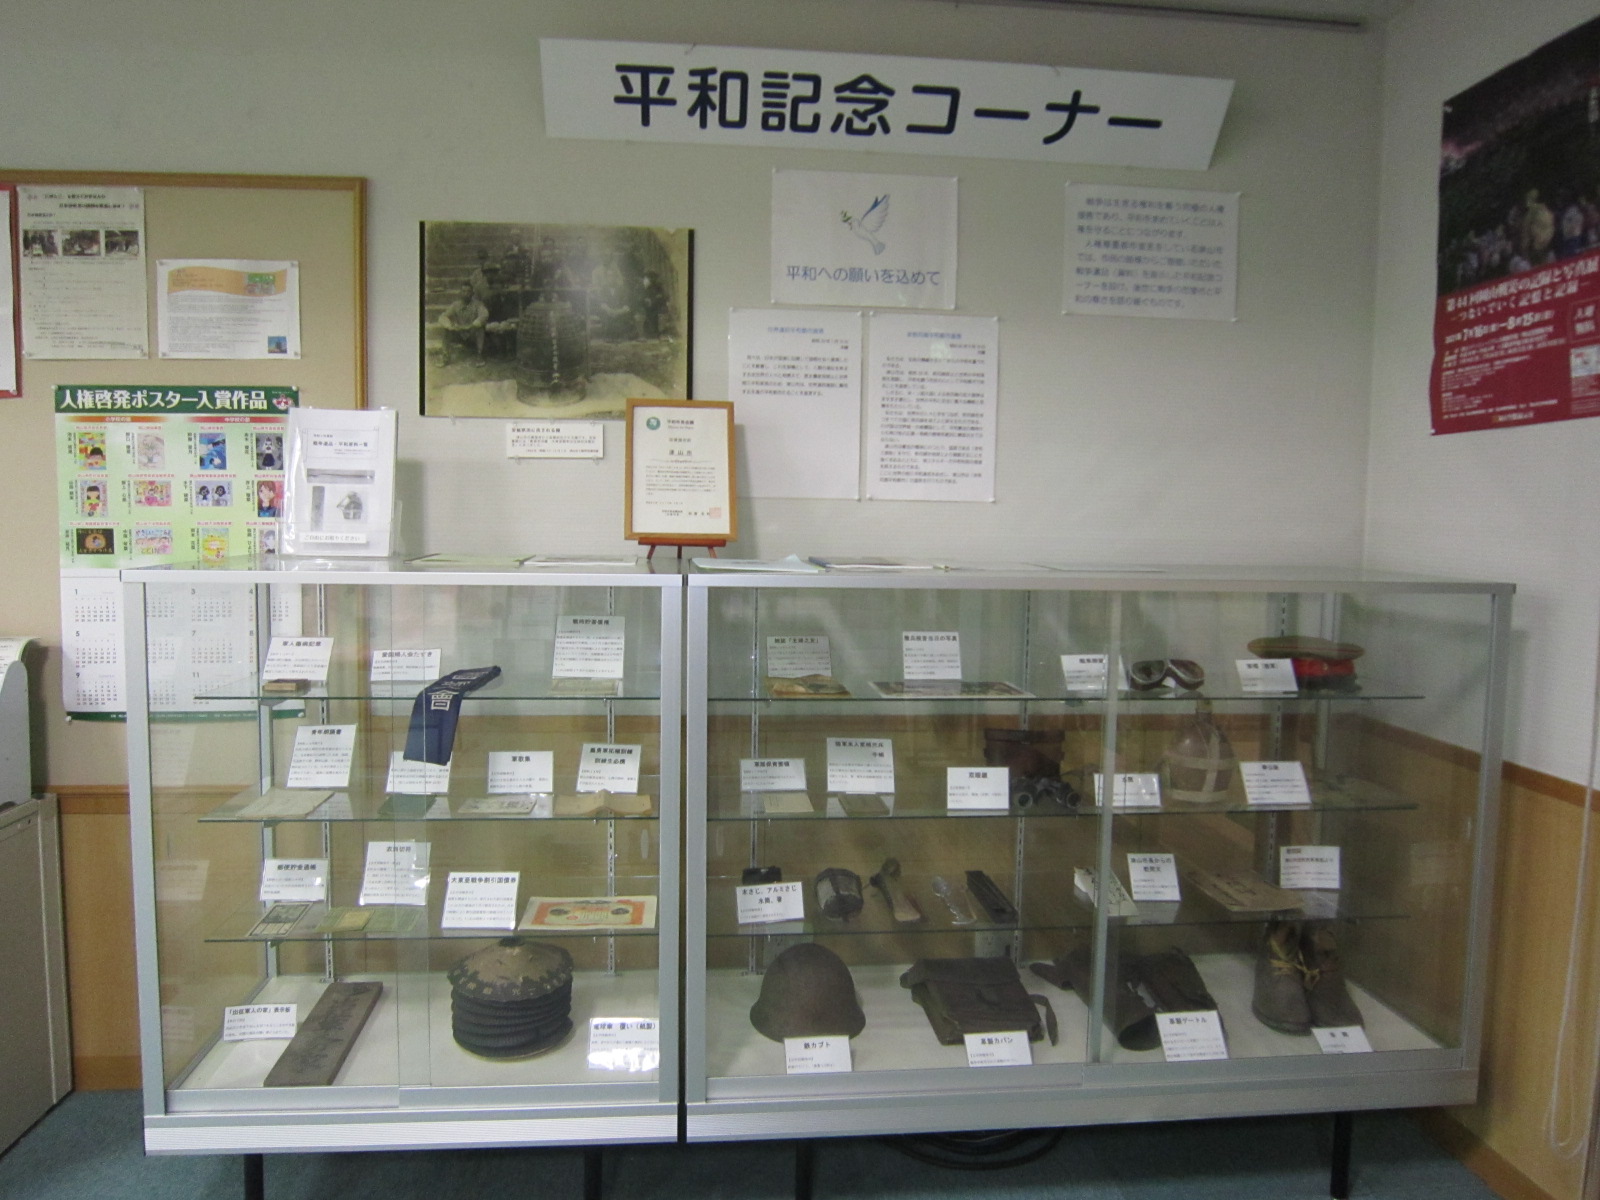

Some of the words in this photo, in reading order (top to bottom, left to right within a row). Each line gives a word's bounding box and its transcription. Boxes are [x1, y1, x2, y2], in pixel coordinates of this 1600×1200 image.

[613, 63, 1163, 146] 平和記念コーナー
[786, 265, 941, 286] 平和への願いを込めて
[60, 389, 268, 410] 人権啓発ポスター入賞作品
[803, 1041, 831, 1049] 鉄カブト
